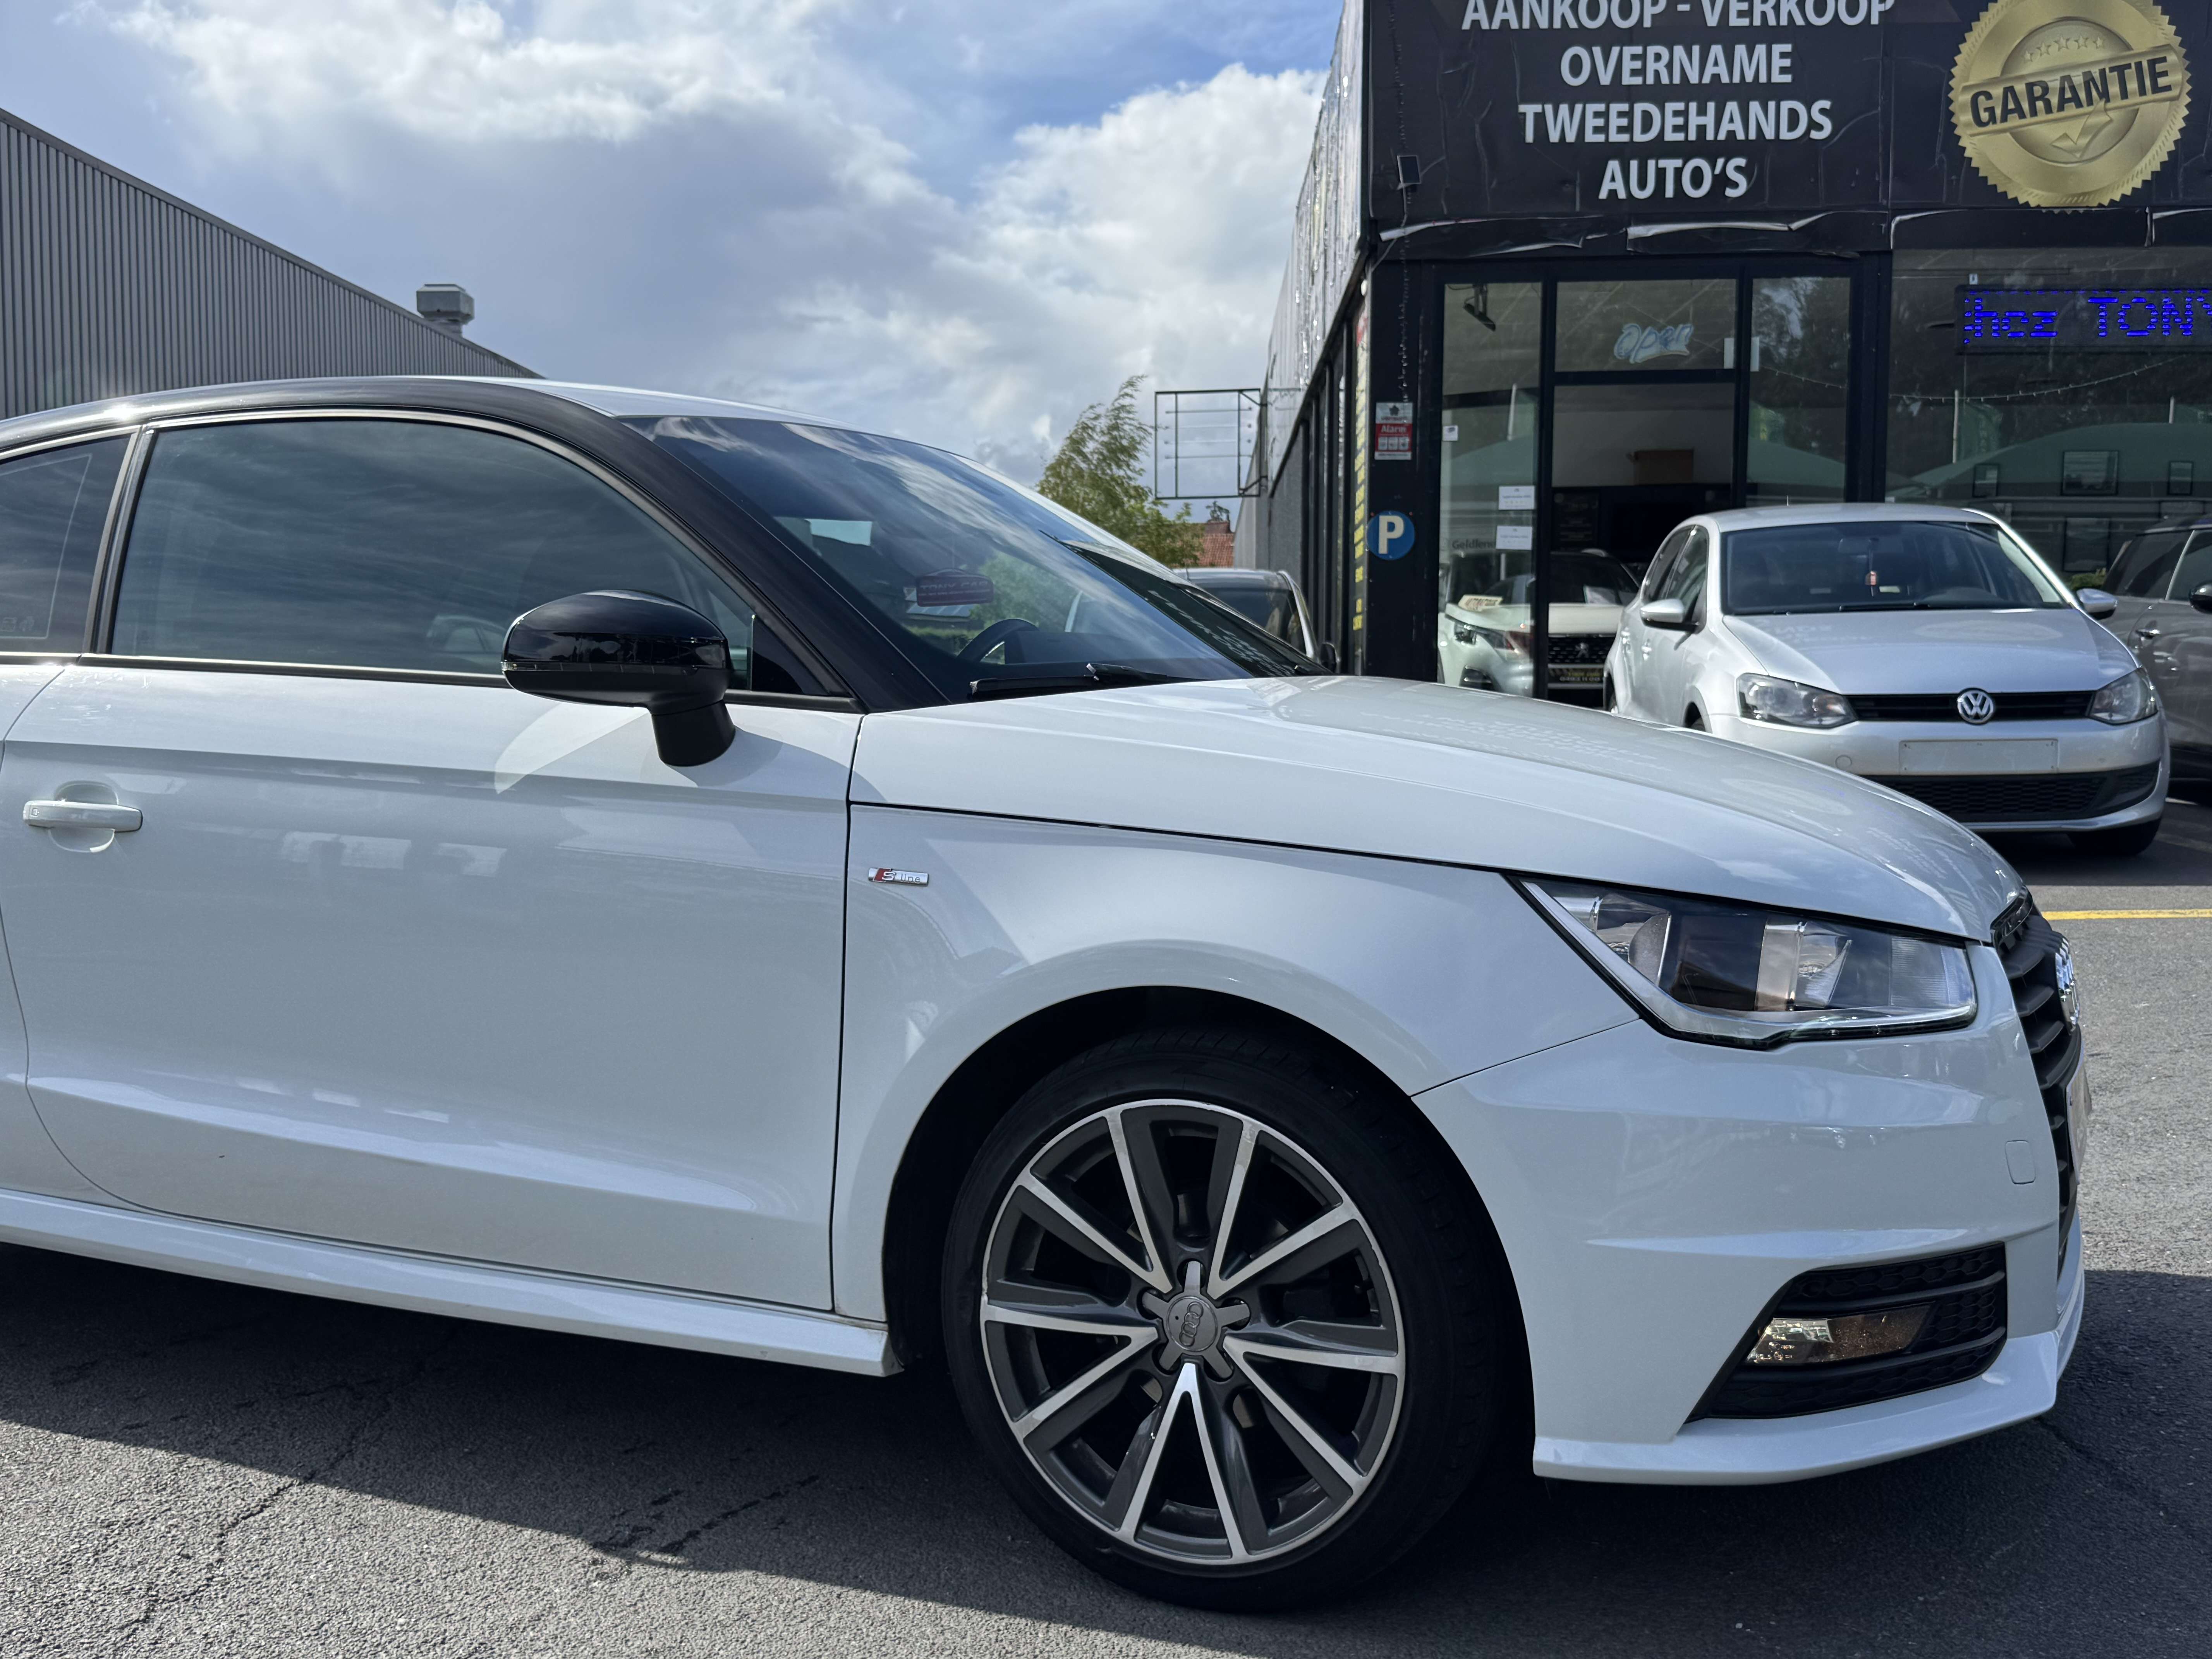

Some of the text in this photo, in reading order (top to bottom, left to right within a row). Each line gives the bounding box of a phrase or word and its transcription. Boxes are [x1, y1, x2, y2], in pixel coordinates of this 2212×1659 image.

[1462, 0, 1666, 29] AANKOOP
[1703, 0, 1894, 27] VERKOOP
[1561, 44, 1792, 86] OVERNAME
[1970, 56, 2172, 127] GARANTIE
[1518, 100, 1832, 142] TWEEDEHANDS
[1381, 425, 1407, 433] Alarm
[1378, 515, 1404, 554] P
[882, 871, 921, 883] S line
